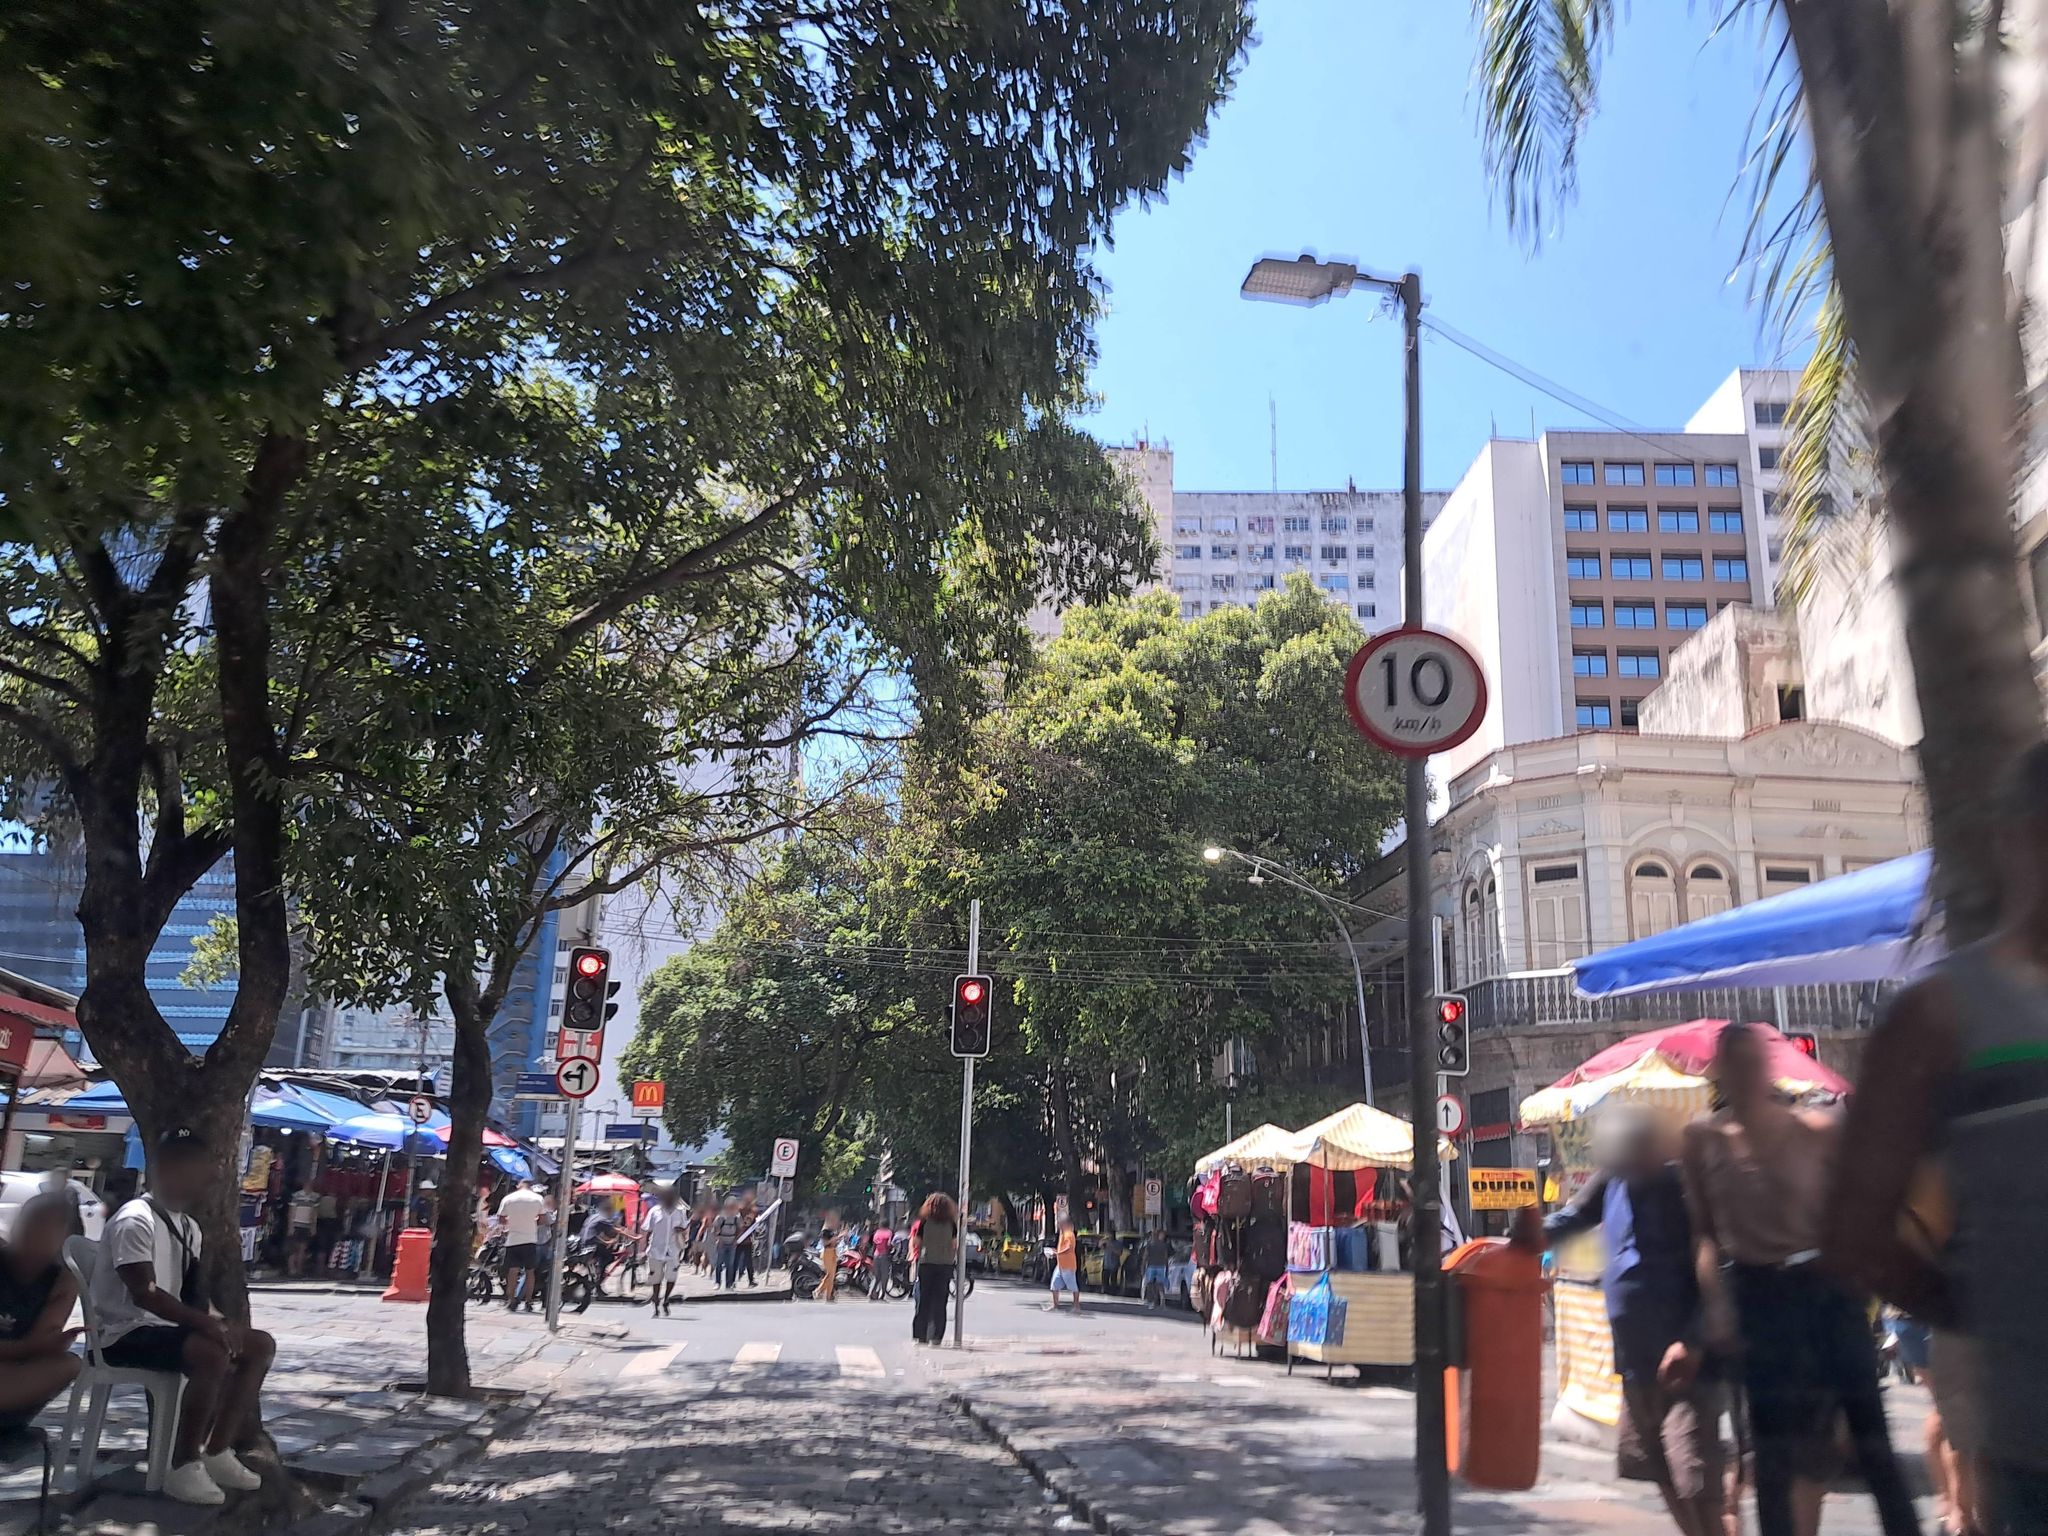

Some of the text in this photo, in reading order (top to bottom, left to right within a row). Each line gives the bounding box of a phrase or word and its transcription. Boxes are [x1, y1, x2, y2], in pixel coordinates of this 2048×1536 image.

[1379, 651, 1453, 712] 10
[1393, 715, 1441, 733] km/h
[782, 1146, 790, 1157] E
[1151, 1184, 1157, 1194] E
